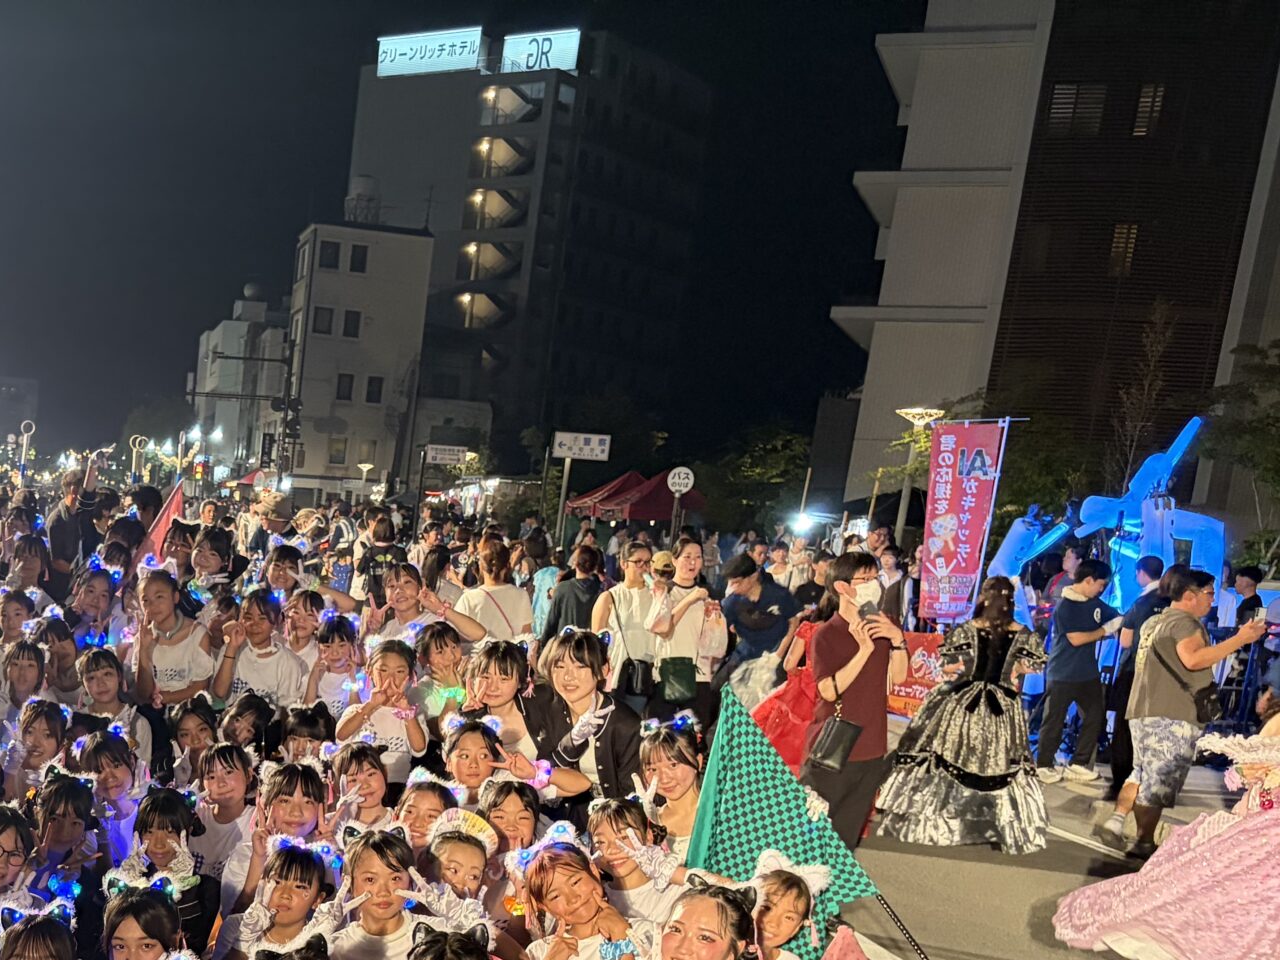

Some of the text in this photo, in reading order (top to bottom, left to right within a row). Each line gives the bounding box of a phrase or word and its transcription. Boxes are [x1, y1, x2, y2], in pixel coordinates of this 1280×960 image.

[379, 39, 479, 65] グリーンリッチホテル
[671, 471, 691, 480] バス
